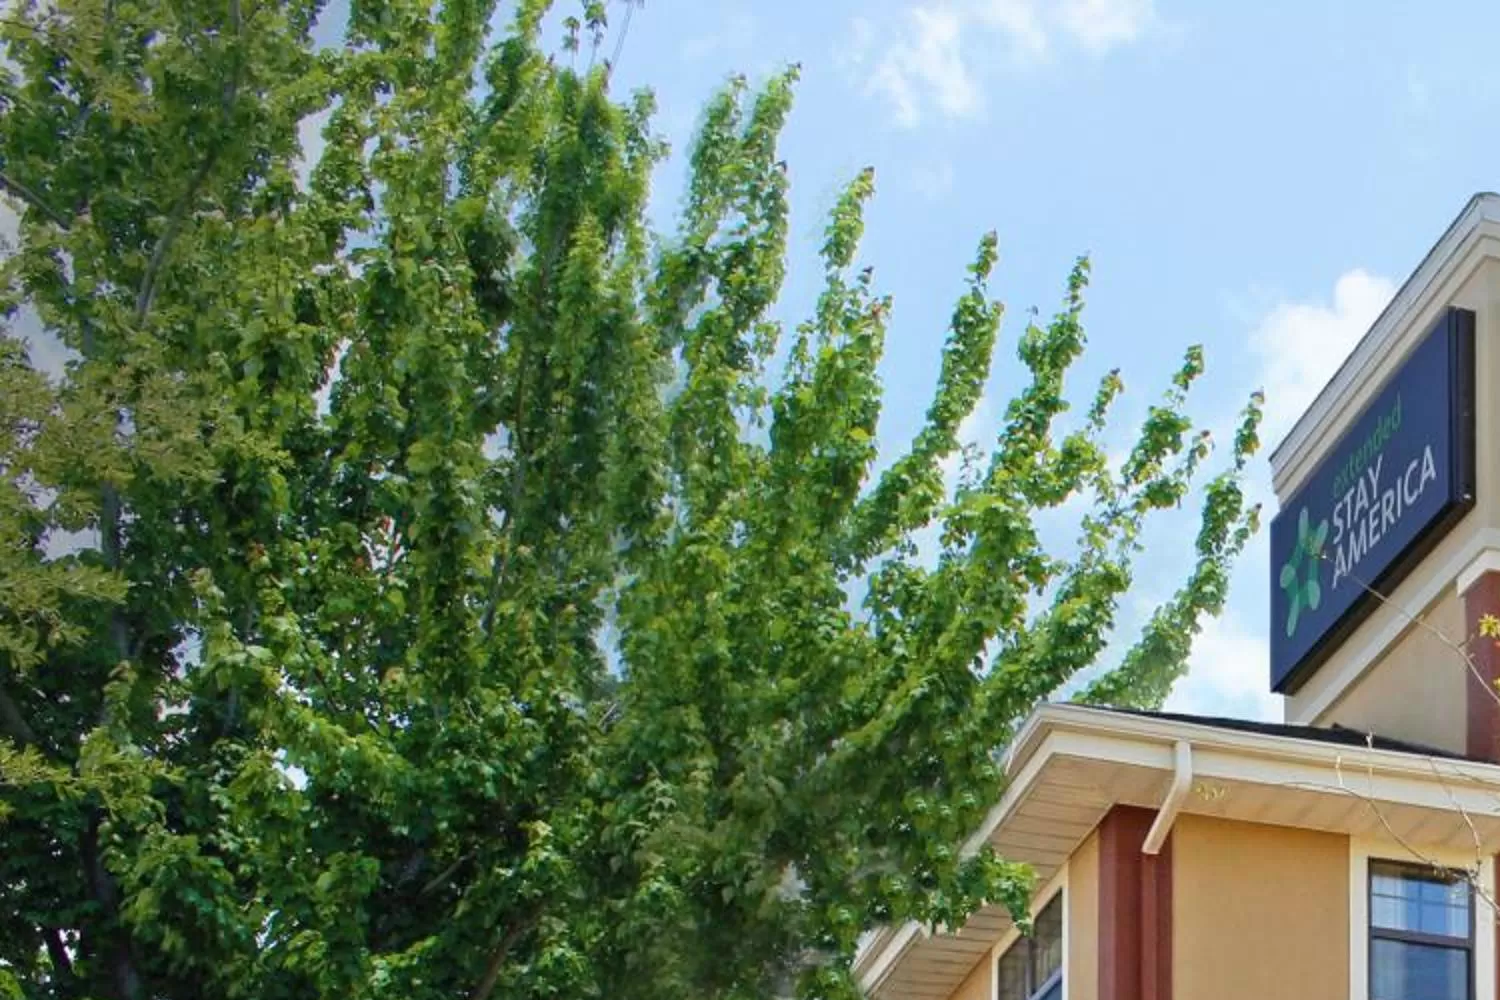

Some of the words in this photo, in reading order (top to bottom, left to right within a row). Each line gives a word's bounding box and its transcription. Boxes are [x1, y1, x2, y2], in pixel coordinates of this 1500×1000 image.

[1333, 394, 1402, 493] extended
[1332, 455, 1383, 544] STAY
[1332, 446, 1436, 588] AMERICA
